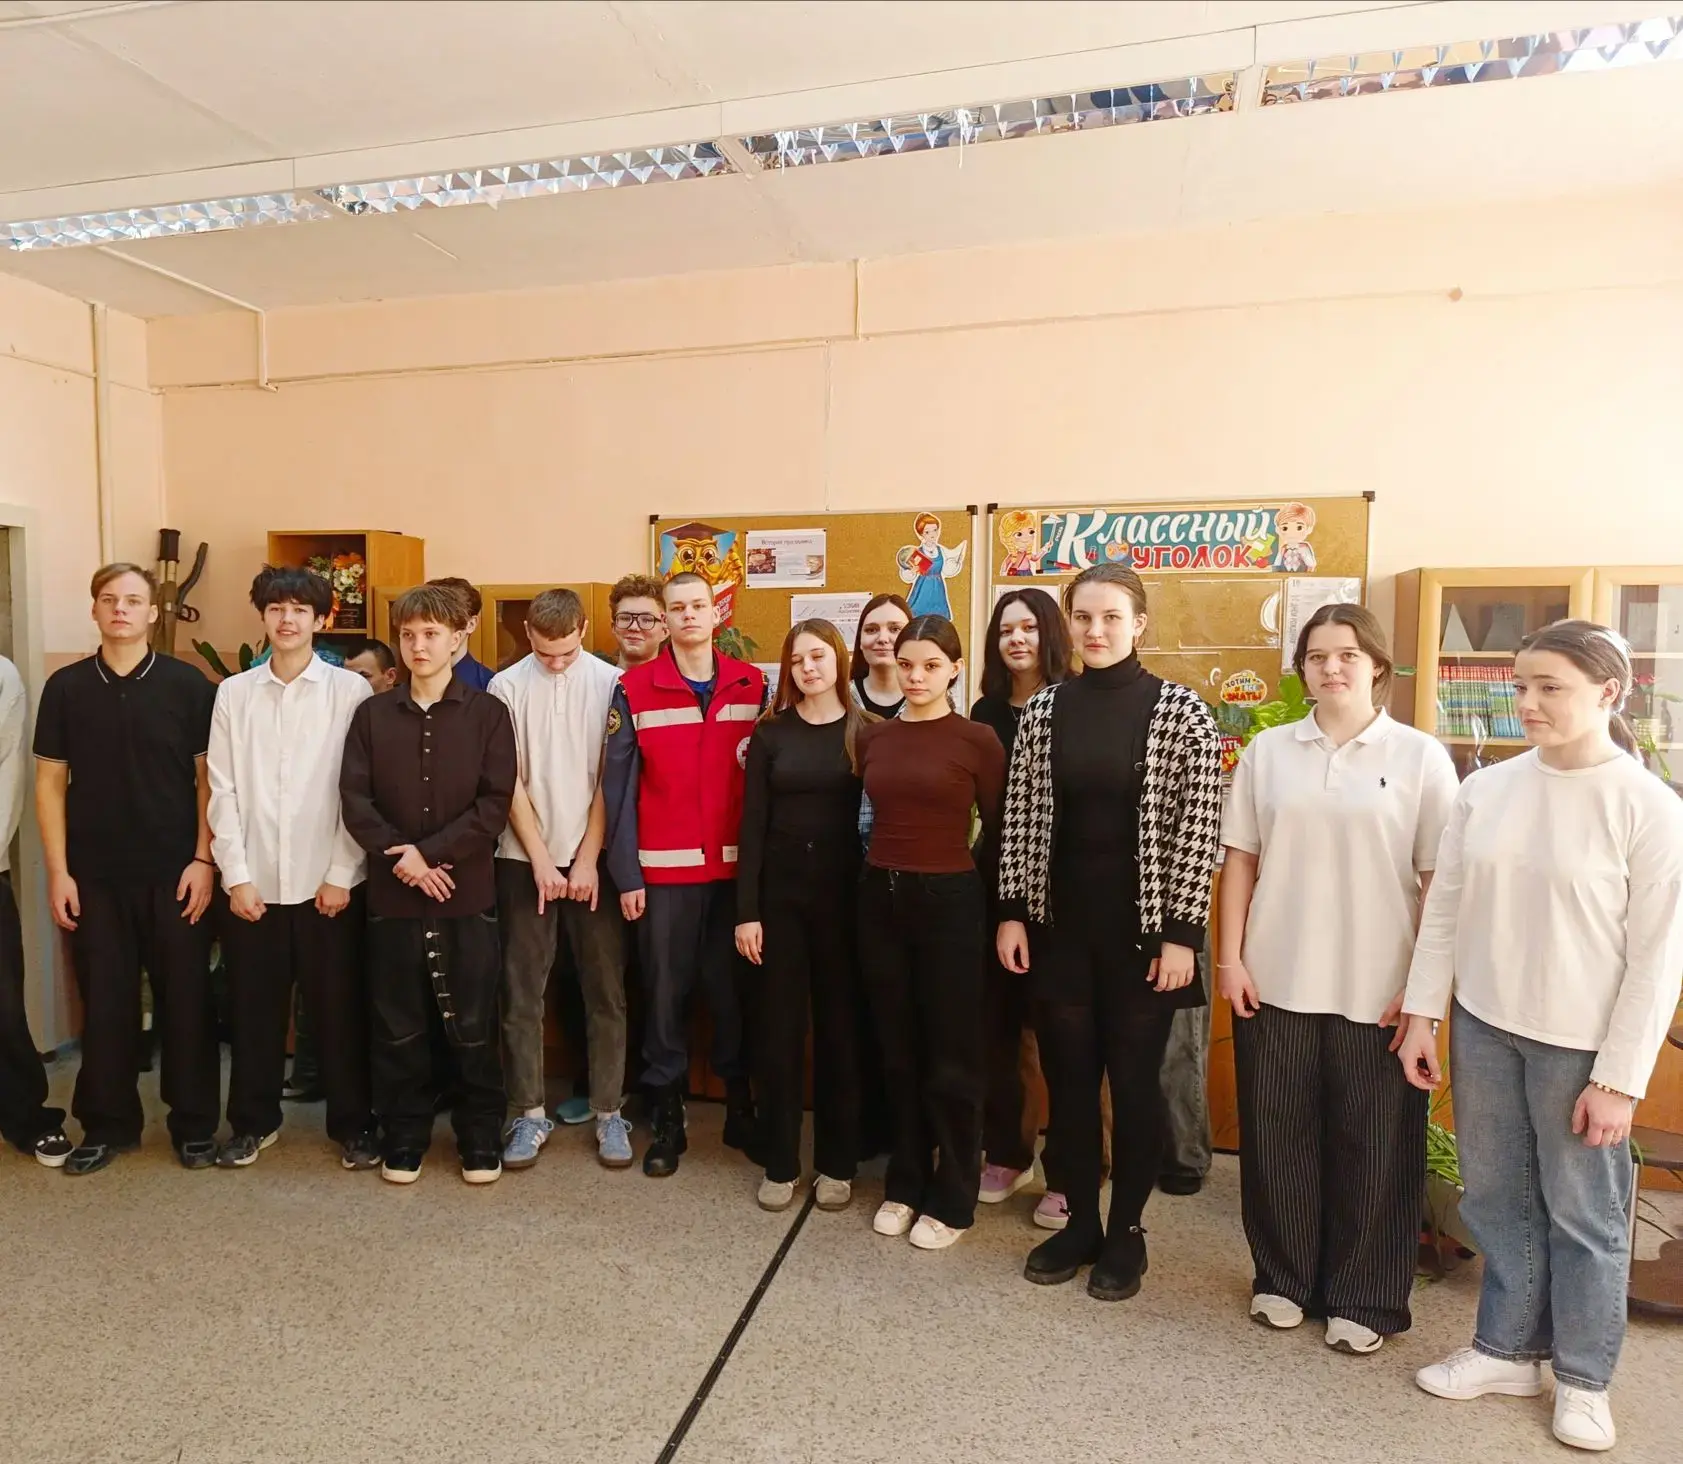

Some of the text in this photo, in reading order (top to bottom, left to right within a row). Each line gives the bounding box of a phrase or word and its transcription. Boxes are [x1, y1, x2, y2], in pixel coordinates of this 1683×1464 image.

[1057, 506, 1270, 569] Классный
[1131, 544, 1252, 570] УГОЛОК
[1225, 678, 1251, 688] ХОТИМ
